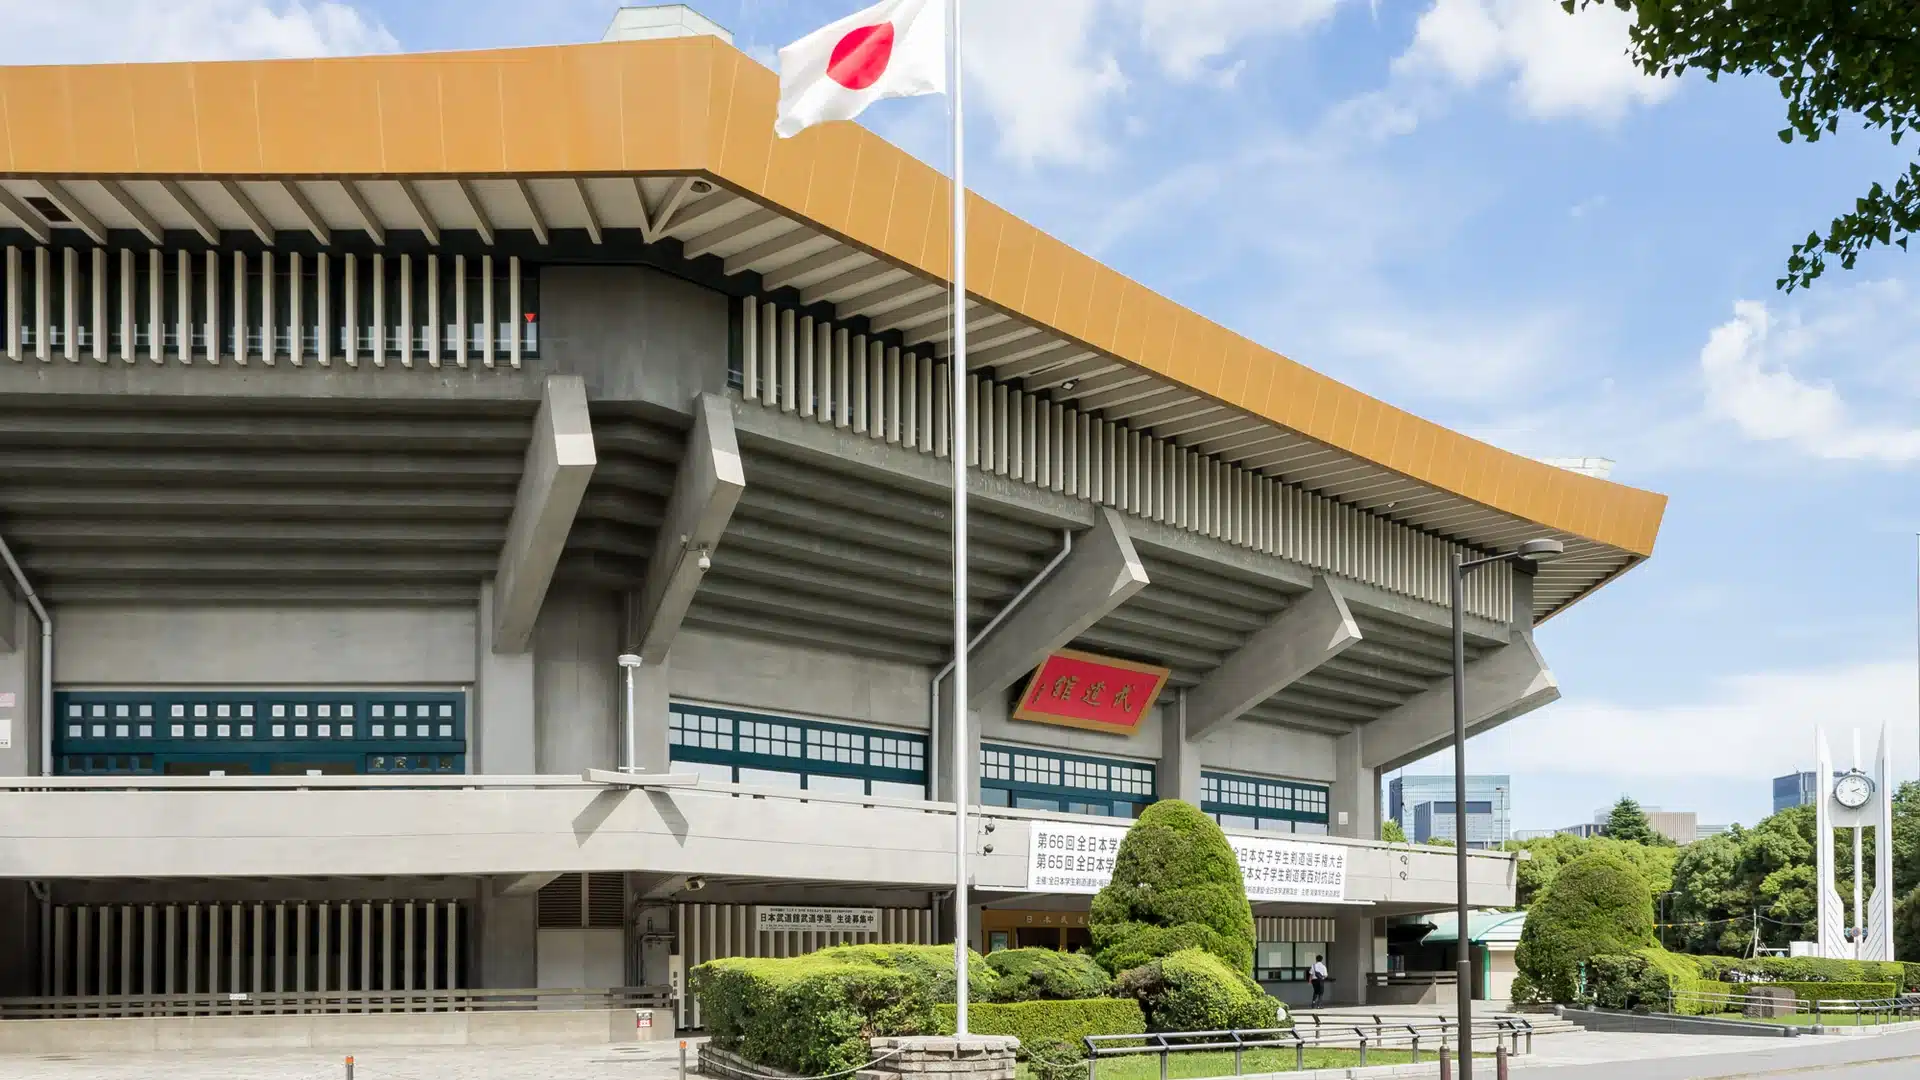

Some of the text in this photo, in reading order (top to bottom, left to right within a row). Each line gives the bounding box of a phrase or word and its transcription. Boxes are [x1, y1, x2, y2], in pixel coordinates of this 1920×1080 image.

[1037, 832, 1118, 854] 第66回全日本学
[1036, 853, 1115, 873] 第65回全日本学
[760, 912, 874, 924] 日本武道館武道学園 生徒募集中
